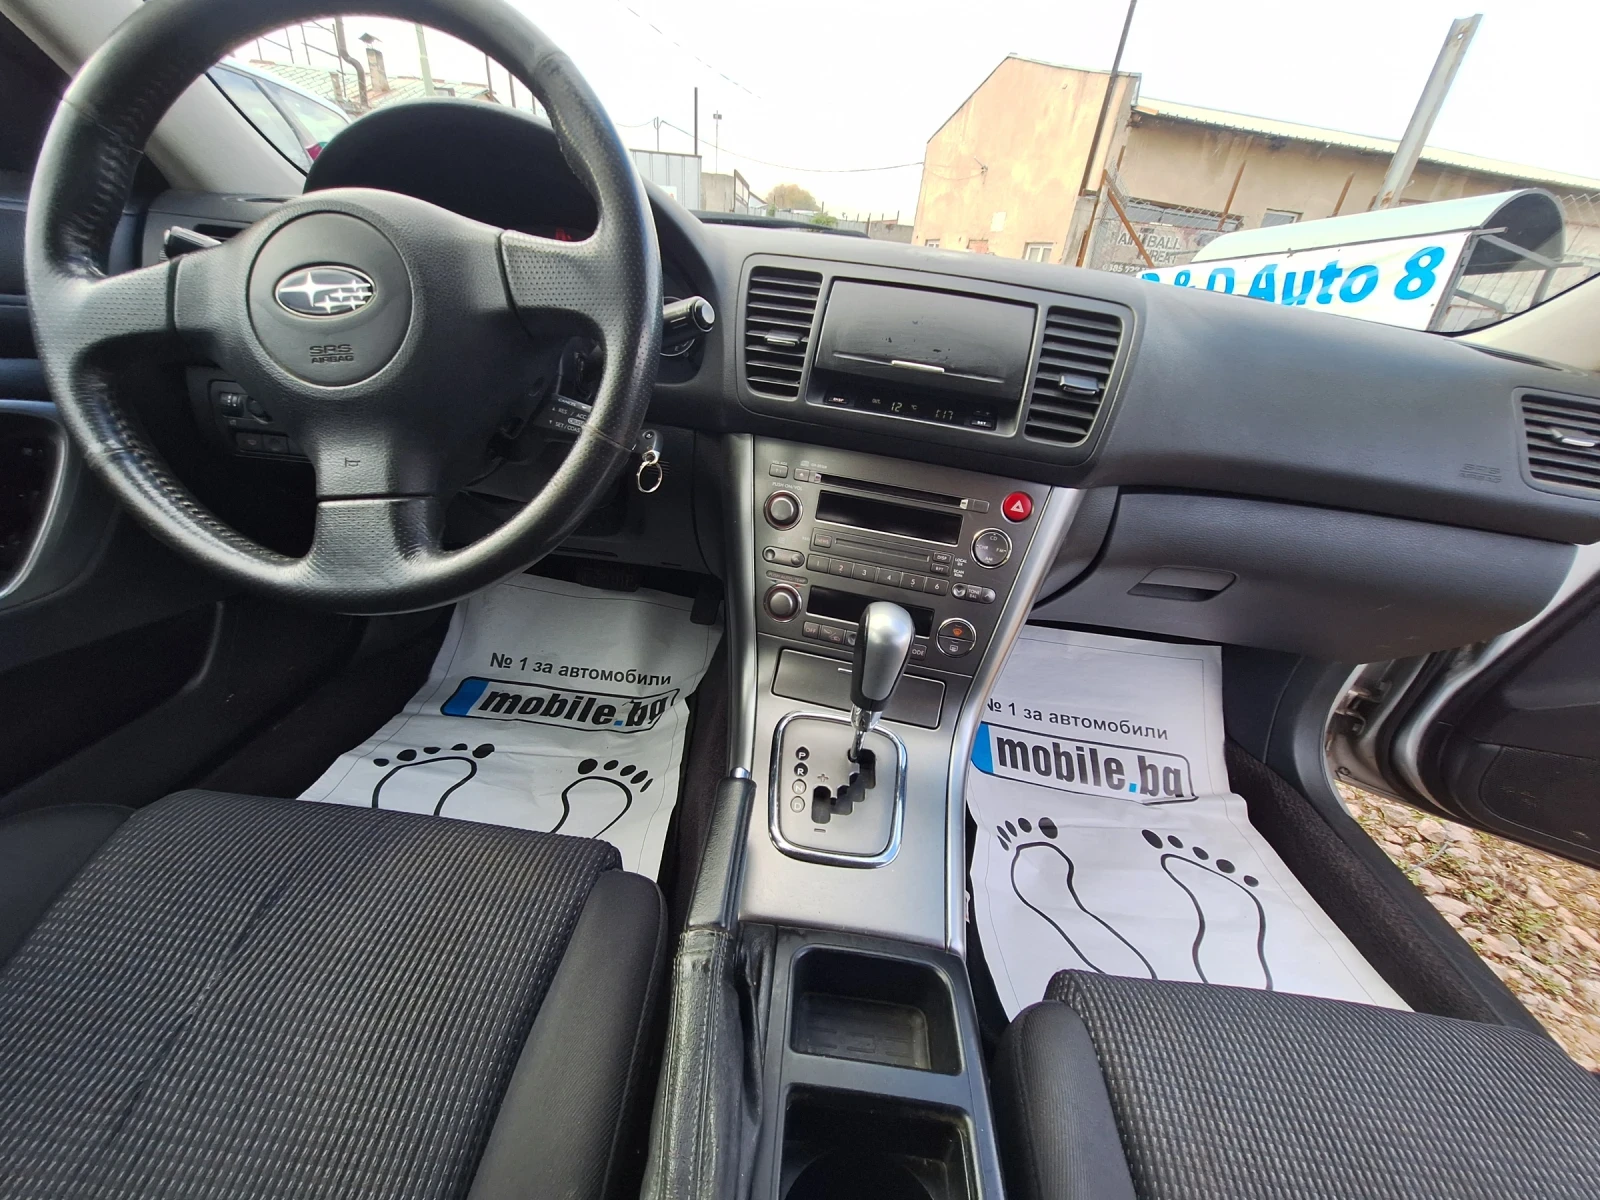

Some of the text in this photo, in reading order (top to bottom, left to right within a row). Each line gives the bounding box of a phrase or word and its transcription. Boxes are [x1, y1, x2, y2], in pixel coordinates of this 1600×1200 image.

[1247, 260, 1379, 306] Auto
[1394, 246, 1445, 301] 8
[309, 343, 353, 355] SRS
[311, 355, 355, 364] AIRBAG
[890, 401, 903, 412] 12
[805, 626, 816, 634] OFF
[911, 648, 925, 656] ODE
[490, 652, 672, 687] № 1 за автомобили
[478, 690, 669, 727] mobile.bg
[1008, 702, 1016, 716] 1
[1023, 708, 1043, 721] за
[1049, 712, 1168, 741] автомобили
[798, 751, 806, 759] P
[797, 767, 804, 776] R
[795, 784, 804, 792] N
